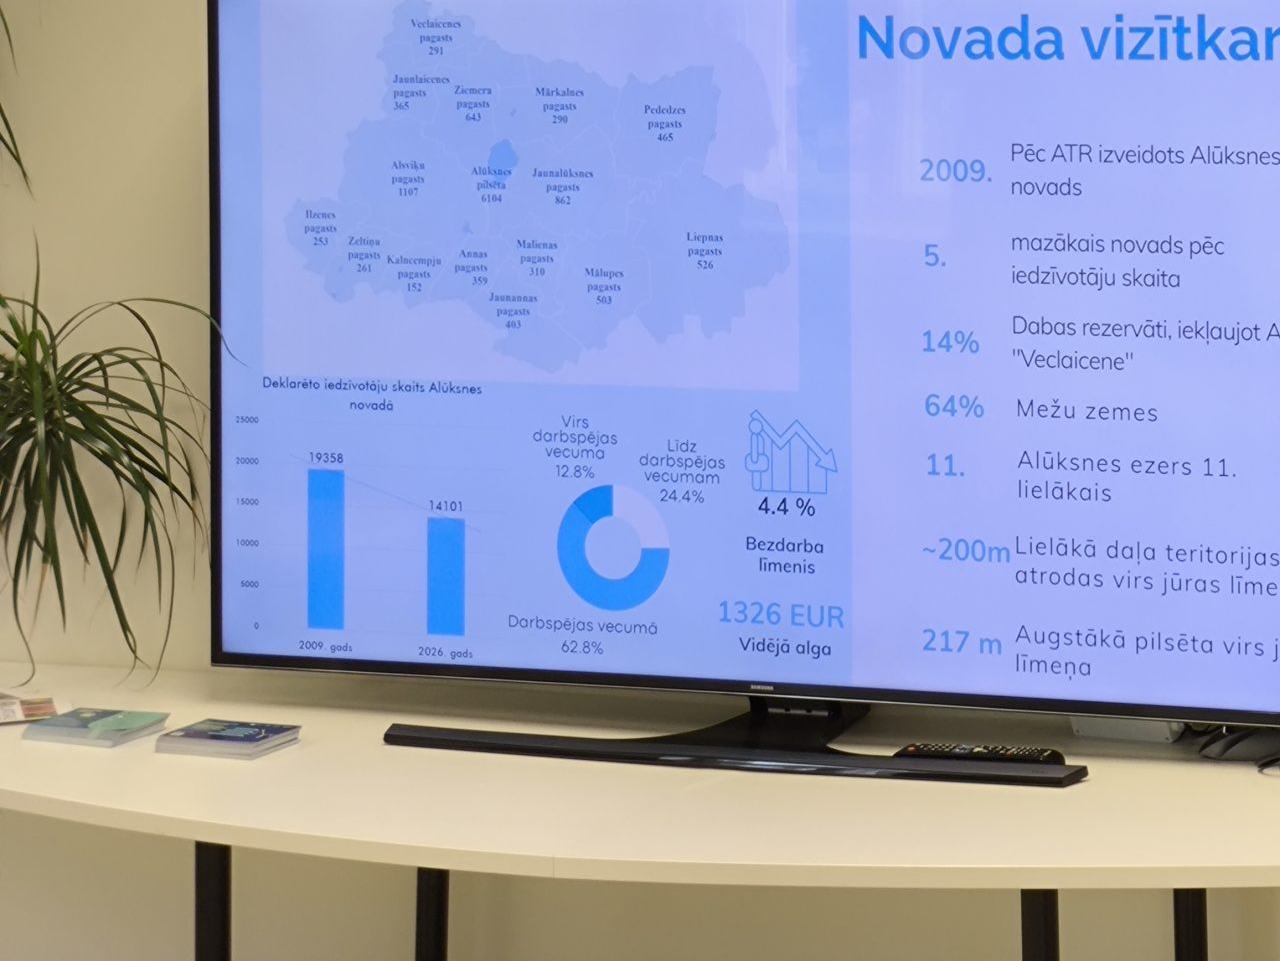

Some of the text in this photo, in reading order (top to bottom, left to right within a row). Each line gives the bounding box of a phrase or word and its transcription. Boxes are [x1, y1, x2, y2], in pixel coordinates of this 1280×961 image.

[411, 19, 461, 28] Veclaicenes
[420, 33, 452, 44] pagasts
[859, 14, 1064, 60] Novada
[429, 46, 443, 55] 291
[393, 74, 450, 84] Jaunlaicenes
[394, 88, 426, 99] pagasts
[454, 85, 491, 95] Ziemera
[536, 87, 584, 96] Mārkalnes
[394, 102, 409, 110] 365
[457, 99, 490, 110] pagasts
[543, 101, 576, 112] pagasts
[645, 105, 686, 114] Pededzes
[466, 113, 481, 121] 643
[553, 115, 568, 124] 290
[648, 119, 682, 130] pagasts
[658, 133, 673, 141] 465
[1012, 143, 1280, 165] Pēc ATR izveidots Alūksnes
[471, 166, 512, 176] Alūksnes
[532, 168, 593, 178] Jaunalūksnes
[921, 159, 992, 182] 2009.
[392, 174, 424, 185] pagasts
[476, 179, 506, 190] pilsēta
[399, 187, 418, 196] 1107
[546, 182, 579, 193] pagasts
[1012, 177, 1082, 196] novads
[481, 194, 502, 203] 6104
[555, 196, 571, 205] 862
[305, 224, 337, 234] pagasts
[314, 237, 328, 246] 253
[687, 232, 723, 243] Liepnas
[517, 240, 557, 249] Malienas
[1012, 233, 1224, 259] mazākais novads pēc
[348, 251, 380, 261] pagasts
[459, 250, 487, 258] Annas
[688, 247, 722, 257] pagasts
[925, 244, 945, 267] 5.
[521, 253, 554, 264] pagasts
[357, 264, 371, 272] 261
[455, 263, 487, 273] pagasts
[697, 260, 713, 269] 526
[398, 269, 431, 279] pagasts
[529, 267, 545, 276] 310
[472, 276, 487, 285] 359
[1012, 265, 1180, 291] iedzīvotāju skaita
[408, 283, 421, 292] 152
[588, 281, 621, 293] pagasts
[489, 292, 537, 302] Jaunannas
[597, 296, 612, 304] 503
[497, 307, 530, 317] pagasts
[506, 320, 521, 328] 403
[1013, 316, 1076, 336] Dabas
[1083, 320, 1171, 340] rezervāti,
[1179, 320, 1260, 345] iekļaujot
[923, 330, 979, 353] 14%
[1013, 349, 1133, 370] "Veclaicene"
[263, 377, 482, 394] Deklarēto iedzīvotāju skaits Alūksnes
[350, 399, 393, 410] novadā
[925, 394, 984, 418] 64%
[1018, 399, 1157, 422] Mežu zemes
[562, 415, 589, 429] Virs
[533, 429, 617, 447] darbspējas
[668, 440, 696, 453] Līdz
[310, 452, 343, 463] 19358
[639, 453, 725, 471] darbspējas
[928, 453, 964, 476] 11.
[1018, 451, 1235, 477] Alūksnes ezers 11.
[556, 465, 594, 478] 12.8%
[644, 472, 719, 484] vecumam
[660, 489, 704, 503] 24.4%
[1019, 480, 1111, 502] lielākais
[430, 500, 462, 511] 14101
[758, 497, 815, 516] 4.4 %
[747, 537, 823, 553] Bezdarba
[923, 538, 1010, 563] ~200m
[1016, 536, 1279, 569] Lielākā daļa teritorijas
[760, 557, 815, 574] līmenis
[241, 580, 259, 588] 5000
[1016, 568, 1103, 587] atrodas
[1113, 571, 1153, 590] virs
[1162, 572, 1220, 596] jūras
[720, 601, 844, 628] 1326 EUR
[509, 615, 657, 635] Darbspējas vecumā
[923, 629, 1001, 655] 217 m
[1016, 625, 1125, 650] Augstākā
[1136, 632, 1212, 654] pilsēta
[1223, 636, 1264, 656] virs
[330, 643, 352, 653] gads
[561, 640, 603, 654] 62.8%
[739, 637, 831, 659] Vidējā alga
[450, 649, 472, 660] gads
[1017, 654, 1090, 680] līmeņa
